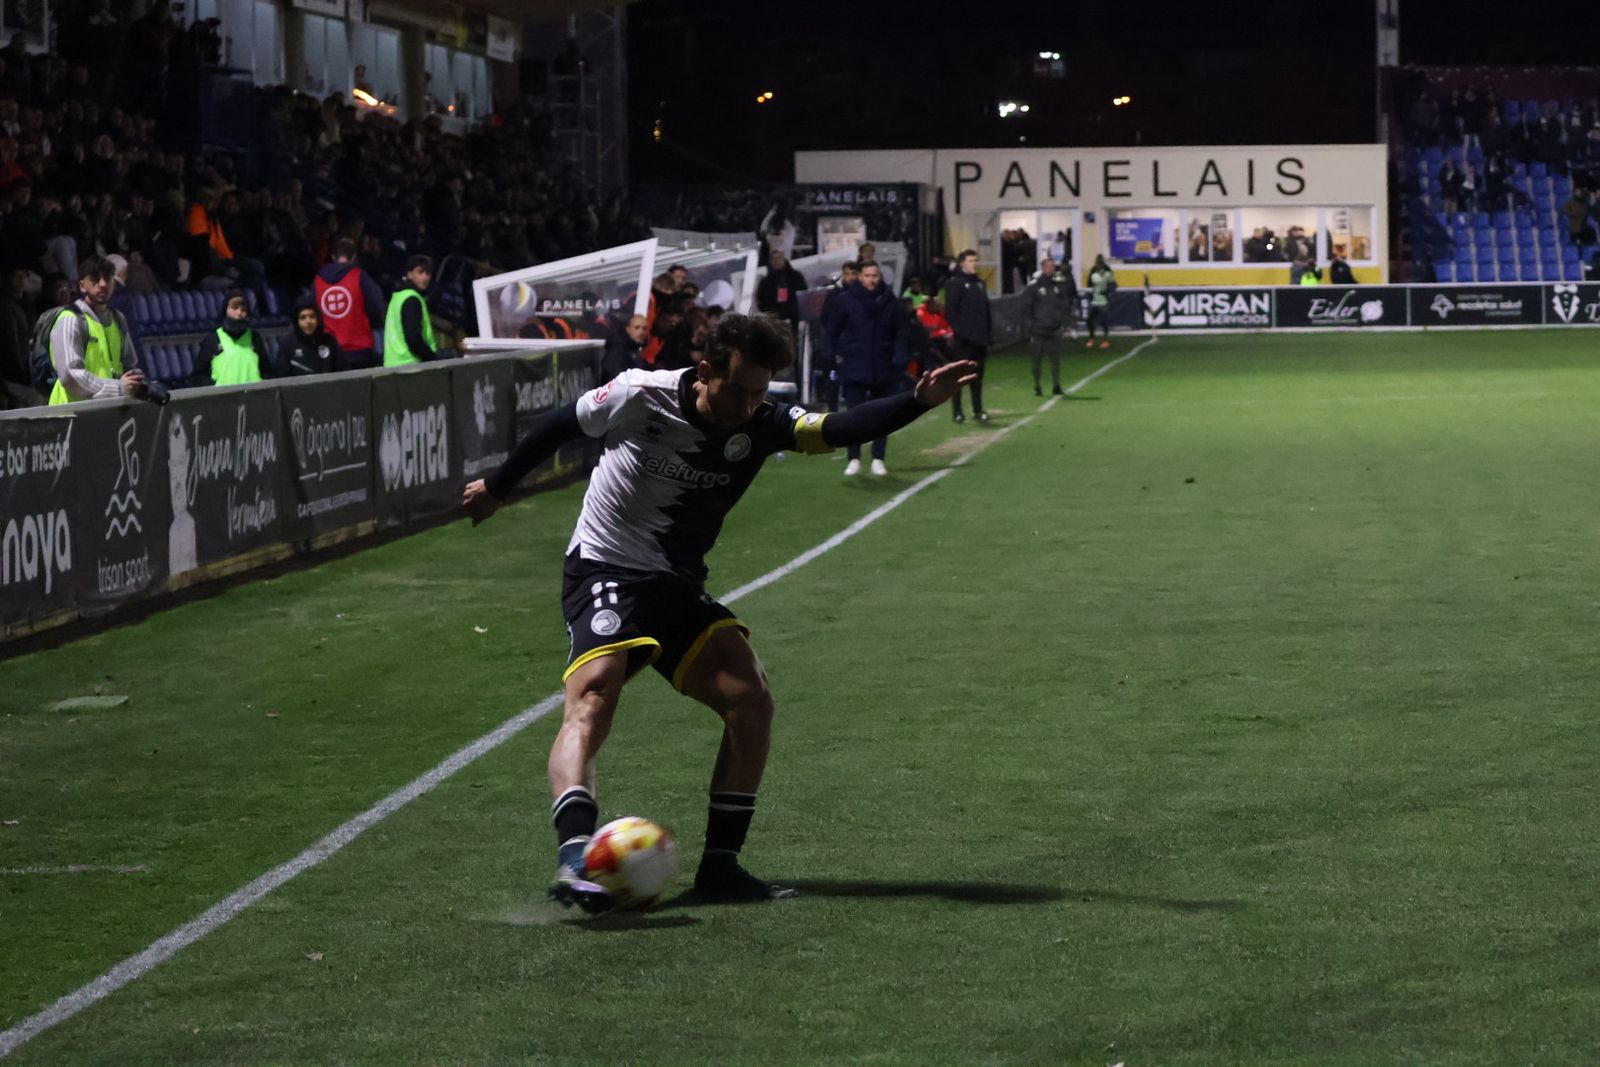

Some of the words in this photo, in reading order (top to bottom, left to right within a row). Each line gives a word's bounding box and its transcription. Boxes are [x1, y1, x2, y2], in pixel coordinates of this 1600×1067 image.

[955, 157, 1306, 215] PANELAIS
[543, 299, 621, 312] PANELAIS
[1167, 293, 1270, 315] MIRSAN
[7, 440, 29, 477] bar
[637, 451, 732, 489] telefurgo
[590, 581, 619, 608] 11
